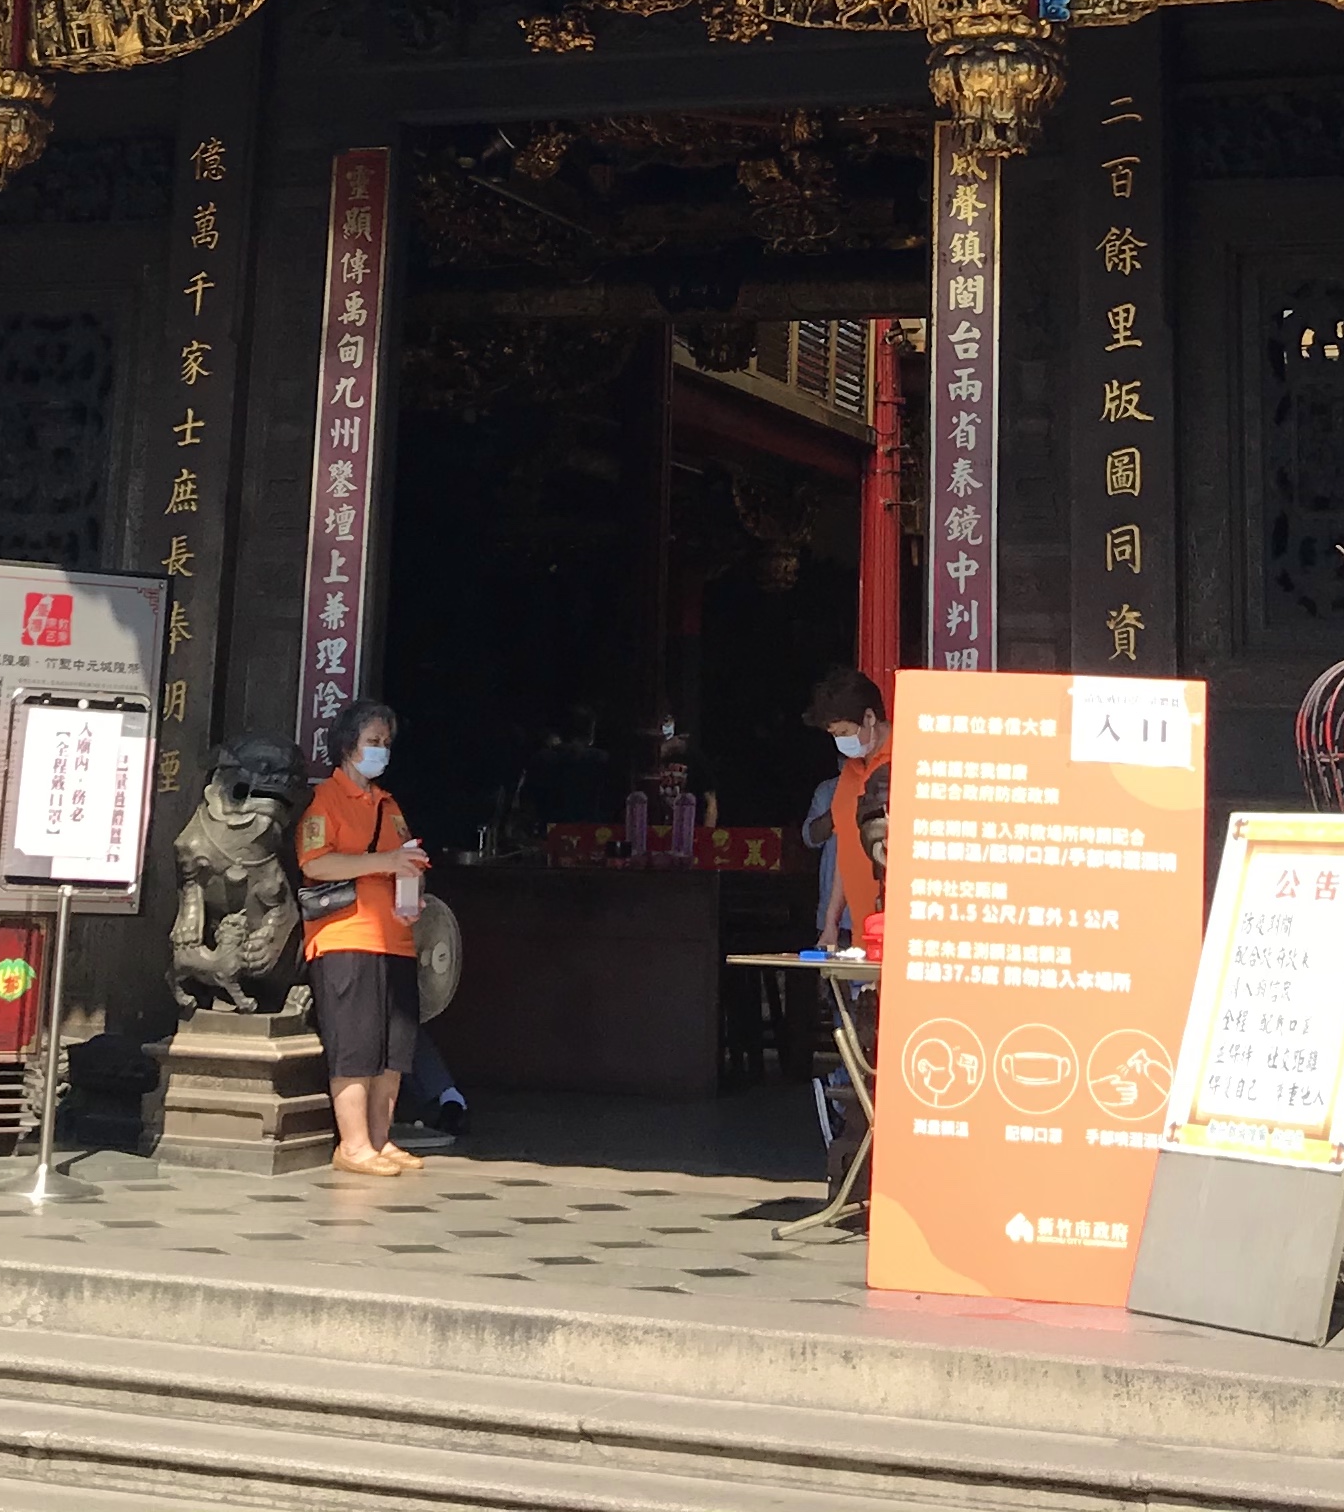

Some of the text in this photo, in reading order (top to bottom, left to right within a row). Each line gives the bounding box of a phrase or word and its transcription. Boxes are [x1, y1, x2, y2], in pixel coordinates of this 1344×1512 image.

[1095, 96, 1155, 661] 二百餘里版圖同資
[915, 782, 1060, 805] 並配合政府防疫政策
[913, 818, 977, 838] 防疫期間
[910, 879, 1008, 900] 保持社交距離
[1275, 869, 1340, 901] 公告
[949, 904, 978, 922] 1.5
[1003, 965, 1132, 994] 請勿進入本場所
[1037, 1216, 1130, 1242] 新竹市政府
